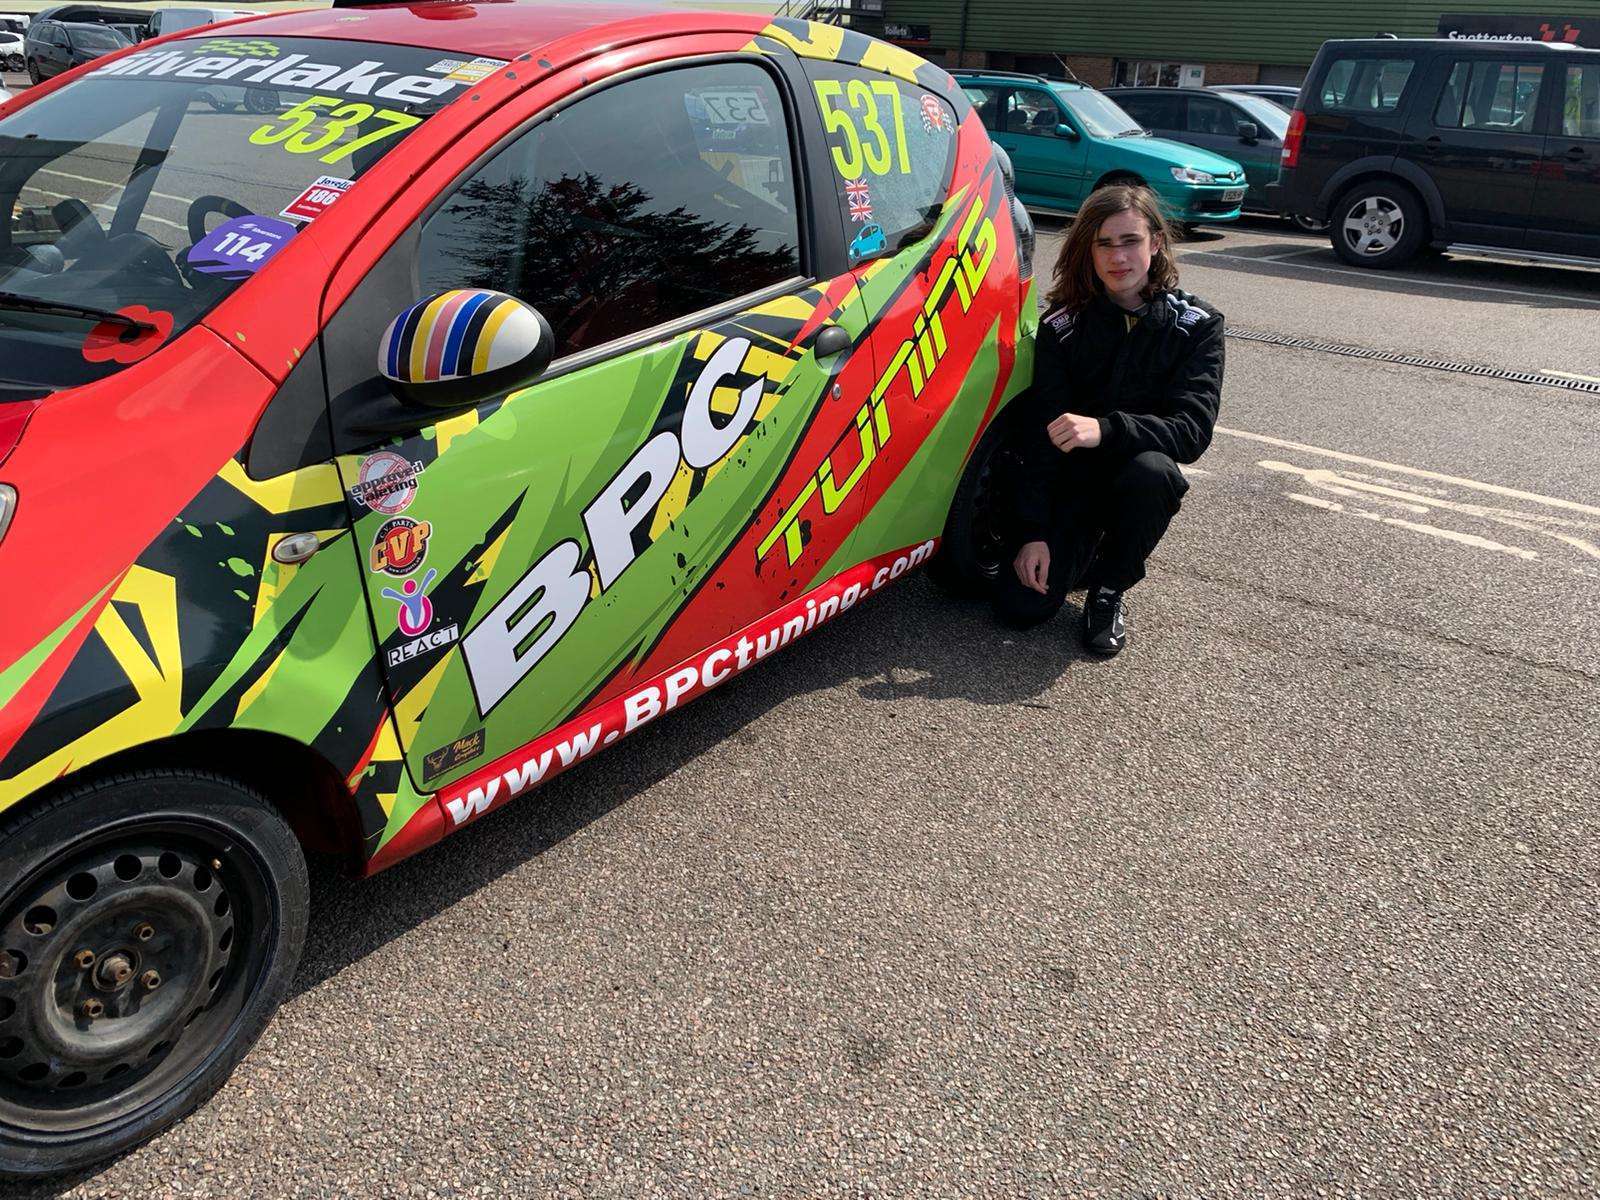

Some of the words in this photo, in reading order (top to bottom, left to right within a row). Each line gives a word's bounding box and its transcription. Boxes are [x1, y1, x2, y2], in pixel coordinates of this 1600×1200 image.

[884, 26, 907, 36] Toilets
[83, 51, 458, 104] Silverlake
[249, 95, 424, 165] 537
[814, 79, 911, 180] 537
[305, 188, 341, 206] 186
[213, 231, 273, 263] 114
[351, 460, 425, 495] approved
[371, 521, 430, 571] CVP
[391, 519, 415, 528] PARTS
[459, 336, 766, 719] BPC
[389, 624, 456, 666] REACT
[445, 539, 936, 827] www.BPCtuning.com
